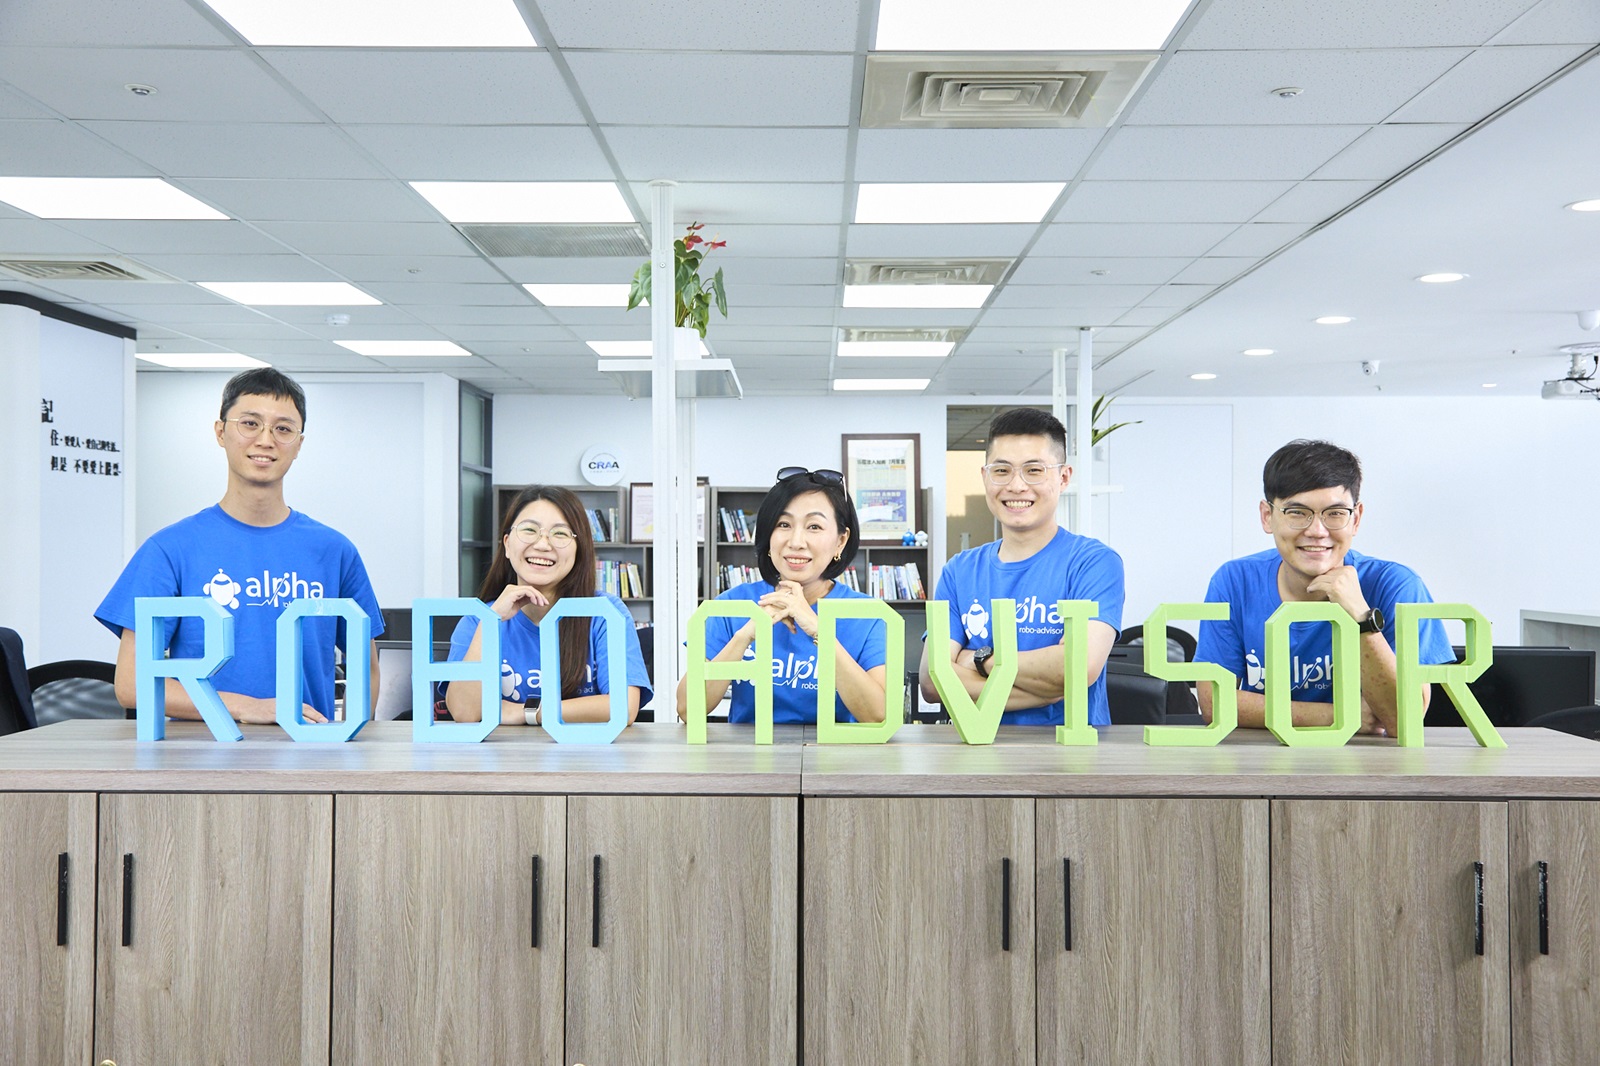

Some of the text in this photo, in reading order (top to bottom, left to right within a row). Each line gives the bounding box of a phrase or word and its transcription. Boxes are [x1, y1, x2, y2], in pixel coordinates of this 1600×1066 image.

[588, 461, 620, 470] CRAA
[245, 570, 324, 608] alpha
[1016, 596, 1065, 624] pha
[1018, 626, 1064, 635] robo-advisor
[135, 597, 1508, 747] ROBO ADVISOR
[772, 652, 818, 688] alp
